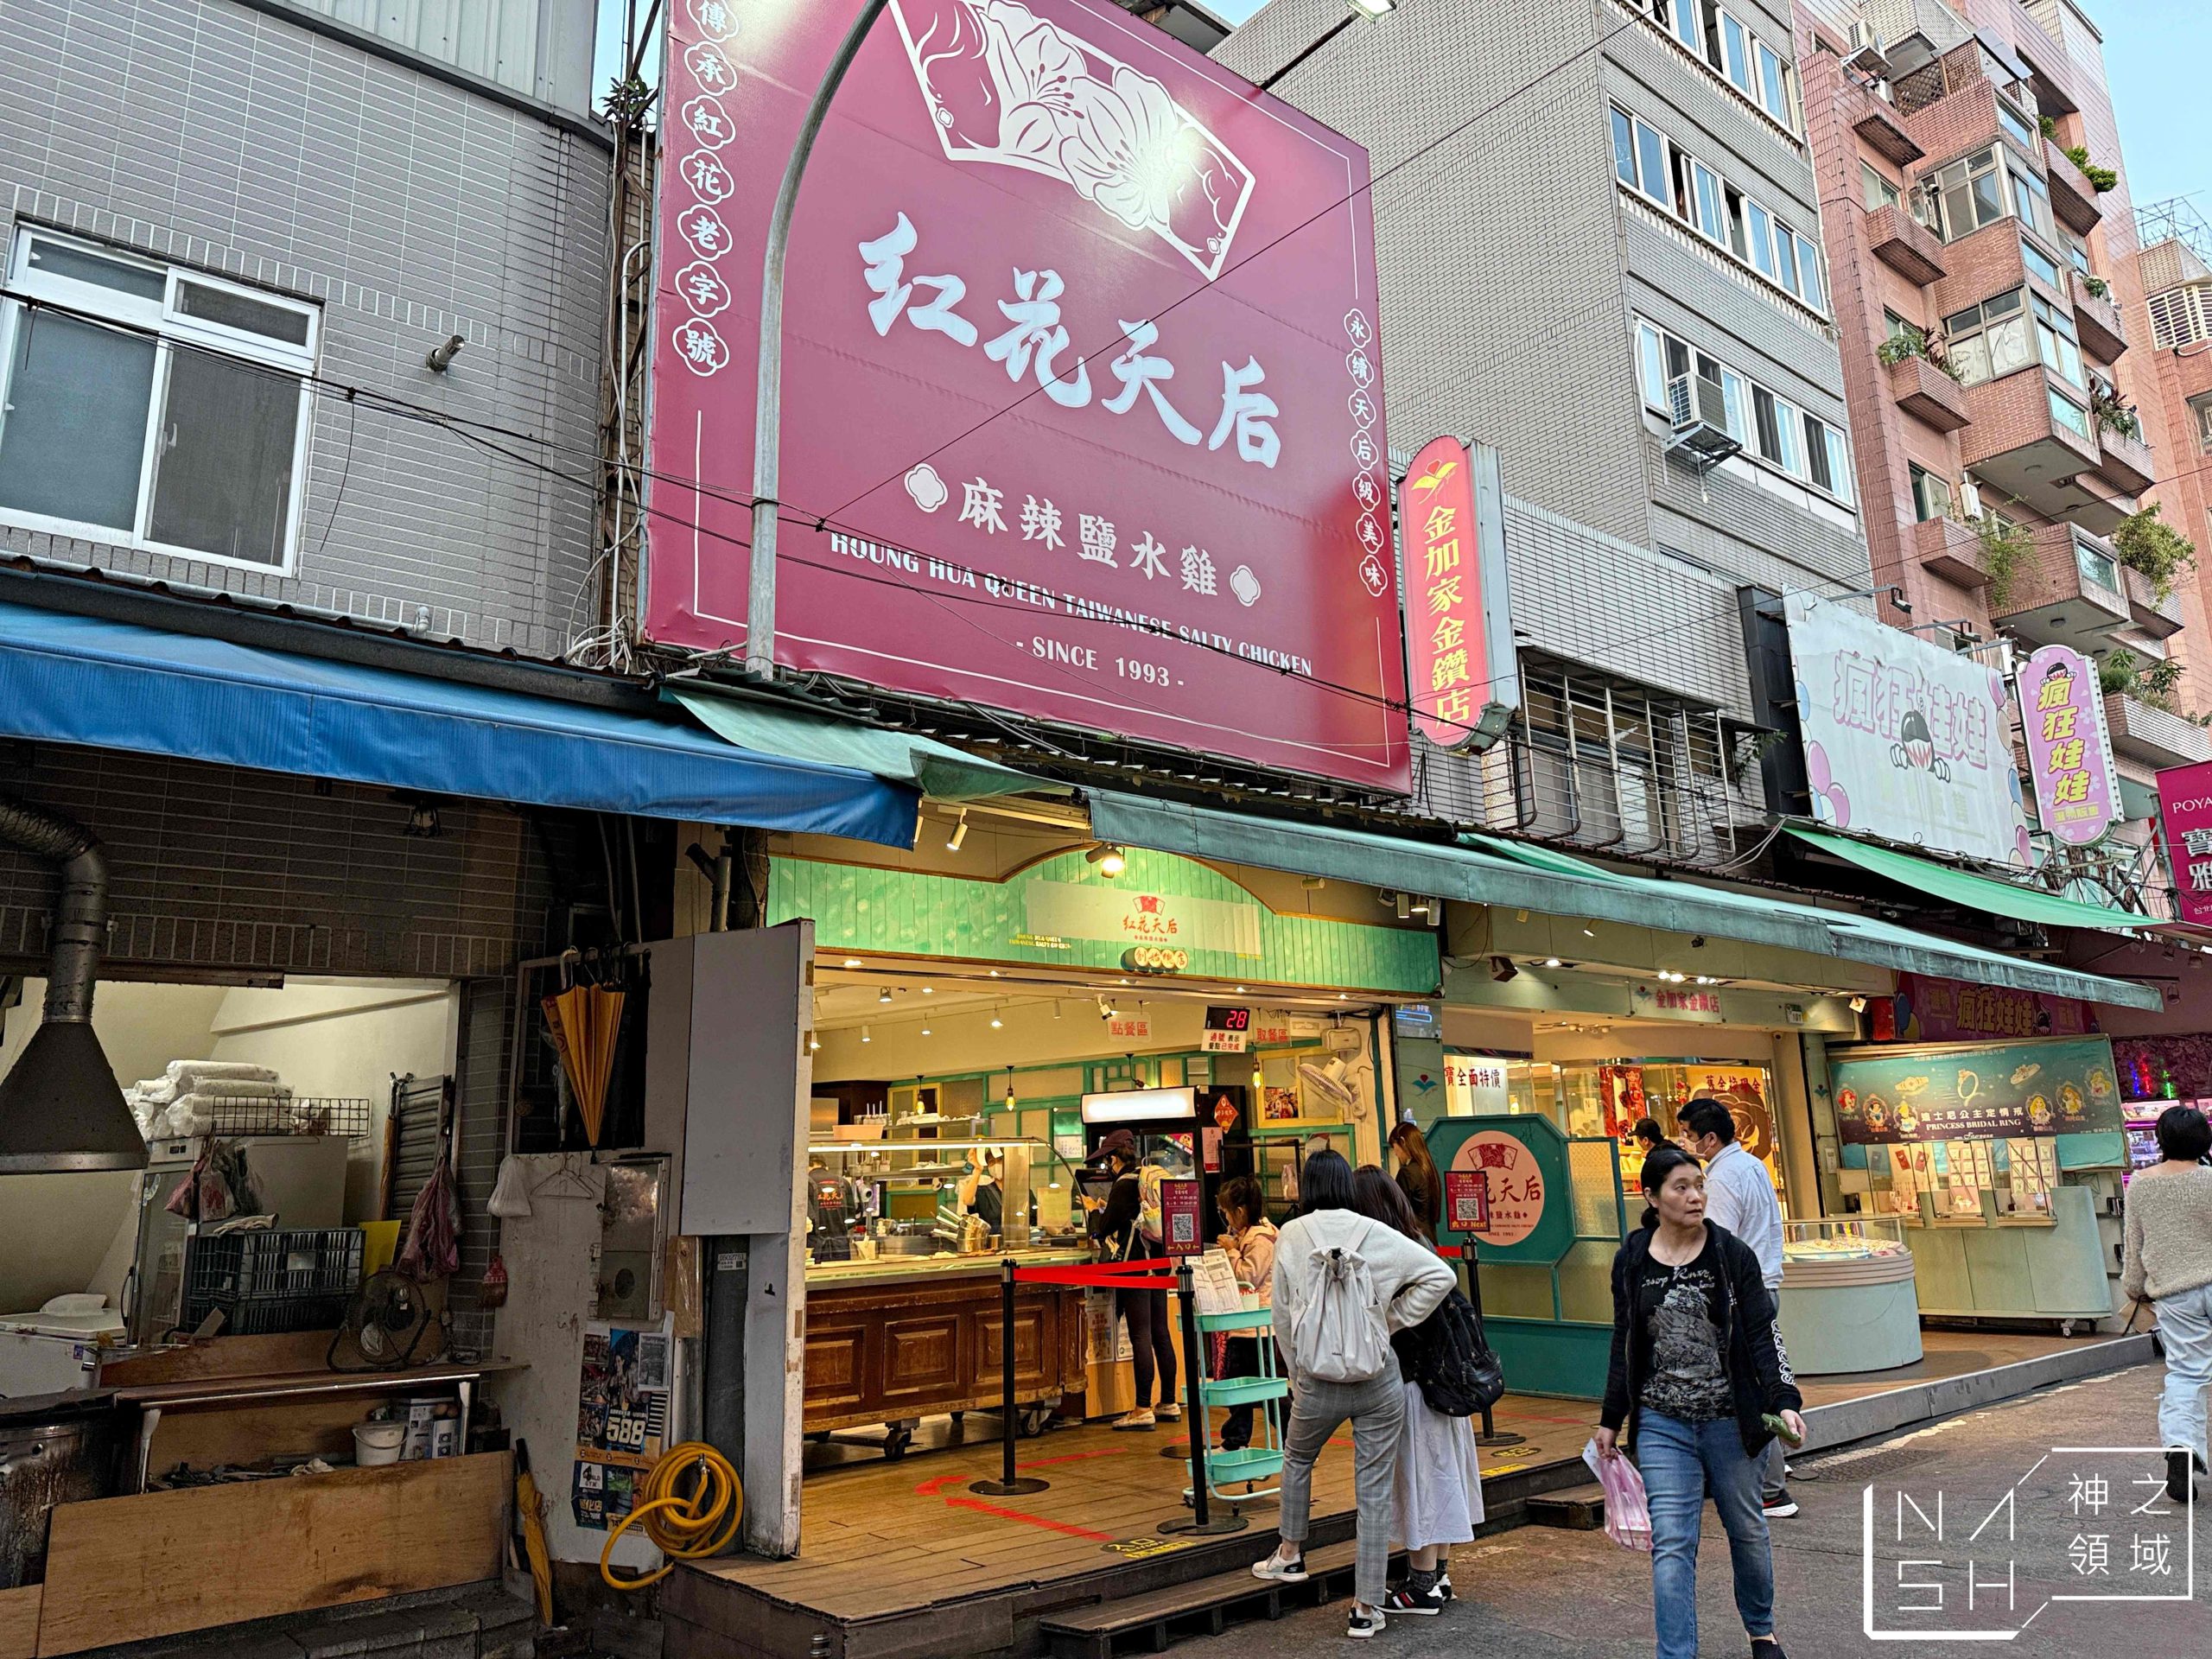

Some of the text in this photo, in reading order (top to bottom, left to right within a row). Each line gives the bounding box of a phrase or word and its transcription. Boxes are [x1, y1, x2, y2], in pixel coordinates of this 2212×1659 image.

[685, 1, 728, 367] 傳承紅花老字號
[1350, 317, 1381, 587] 永續天后級美味
[958, 477, 1217, 595] 麻辣鹽水雞
[831, 532, 1313, 677] HOUNG HUA QUEEN TAIWANESE SALTY CHICKEN
[1423, 505, 1470, 730] 金加家金鑽店
[1033, 636, 1169, 687] SINCE 1993
[2037, 677, 2091, 805] 瘋狂娃娃
[1226, 1010, 1248, 1028] 28
[1656, 988, 1720, 1014] 金加家金鑽店
[1111, 1021, 1148, 1036] 點餐區
[1256, 1027, 1288, 1043] 取餐區
[1926, 1118, 2021, 1131] PRINCESS BRIDAL RING
[607, 1416, 646, 1446] 588
